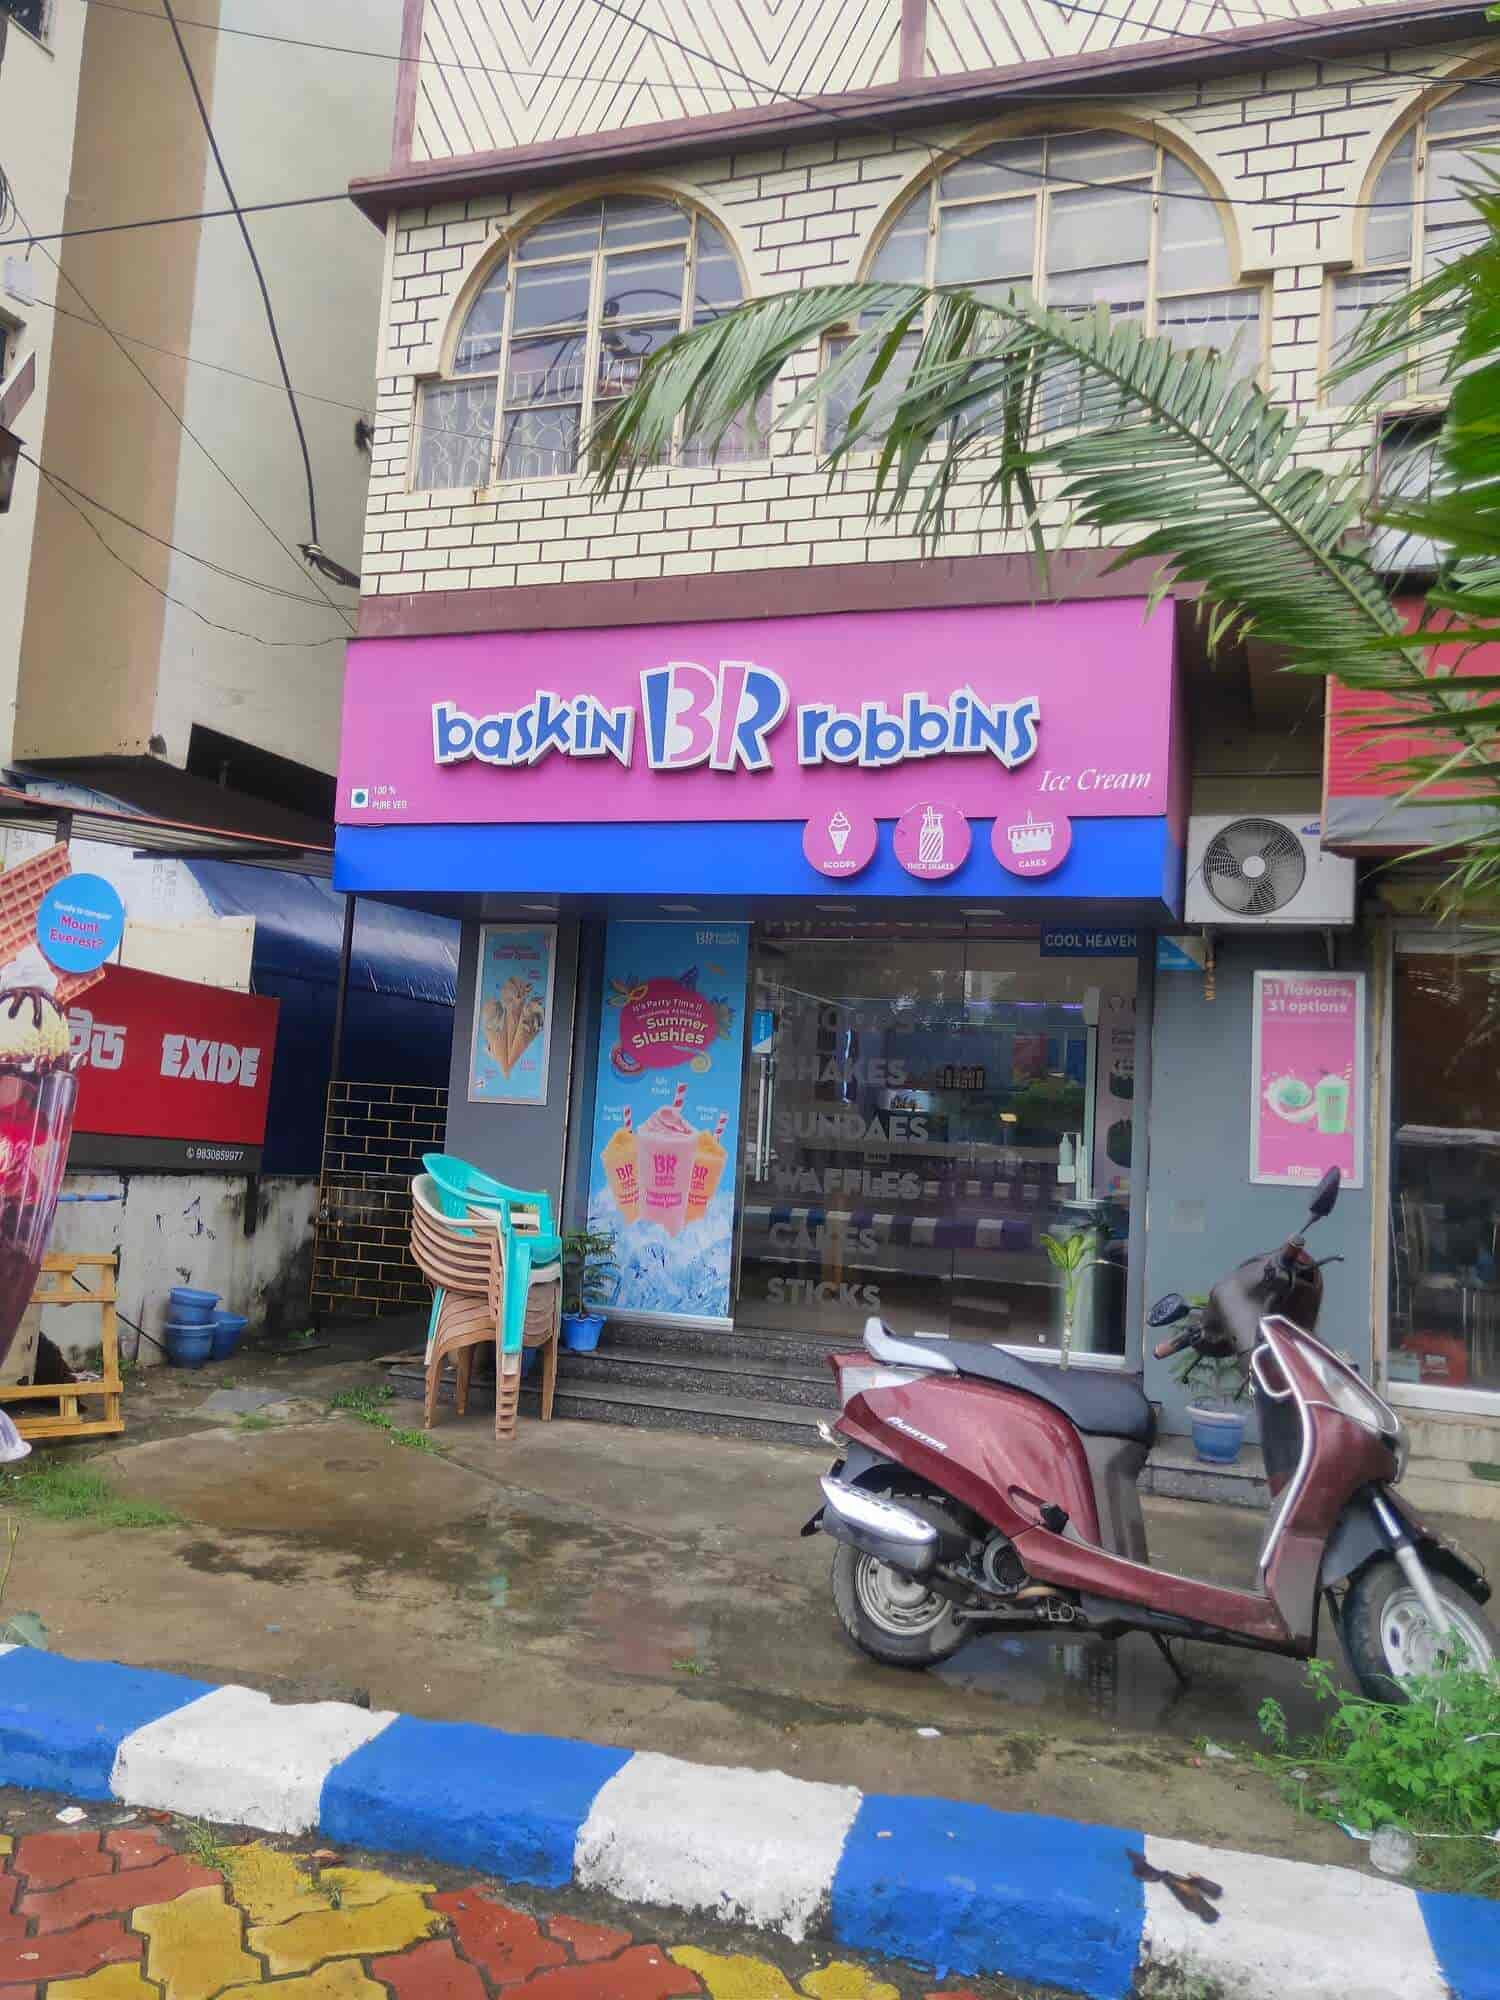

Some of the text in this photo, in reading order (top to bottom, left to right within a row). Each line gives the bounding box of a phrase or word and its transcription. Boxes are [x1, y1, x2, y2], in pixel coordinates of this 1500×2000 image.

[639, 660, 789, 771] BR
[1038, 768, 1151, 792] Ice Cream
[1018, 858, 1047, 869] CAKES
[61, 914, 98, 933] Mount
[49, 927, 104, 951] Everest?
[1044, 934, 1137, 948] COOL HEAVEN
[1288, 999, 1348, 1015] options
[646, 1015, 709, 1033] Summer
[631, 1027, 705, 1048] Slushies
[160, 1033, 261, 1087] EXIDE
[775, 1111, 929, 1144] SUNDAES
[774, 1164, 923, 1200] WAFFLES
[769, 1222, 880, 1253] CAKES
[767, 1277, 881, 1312] STICKS
